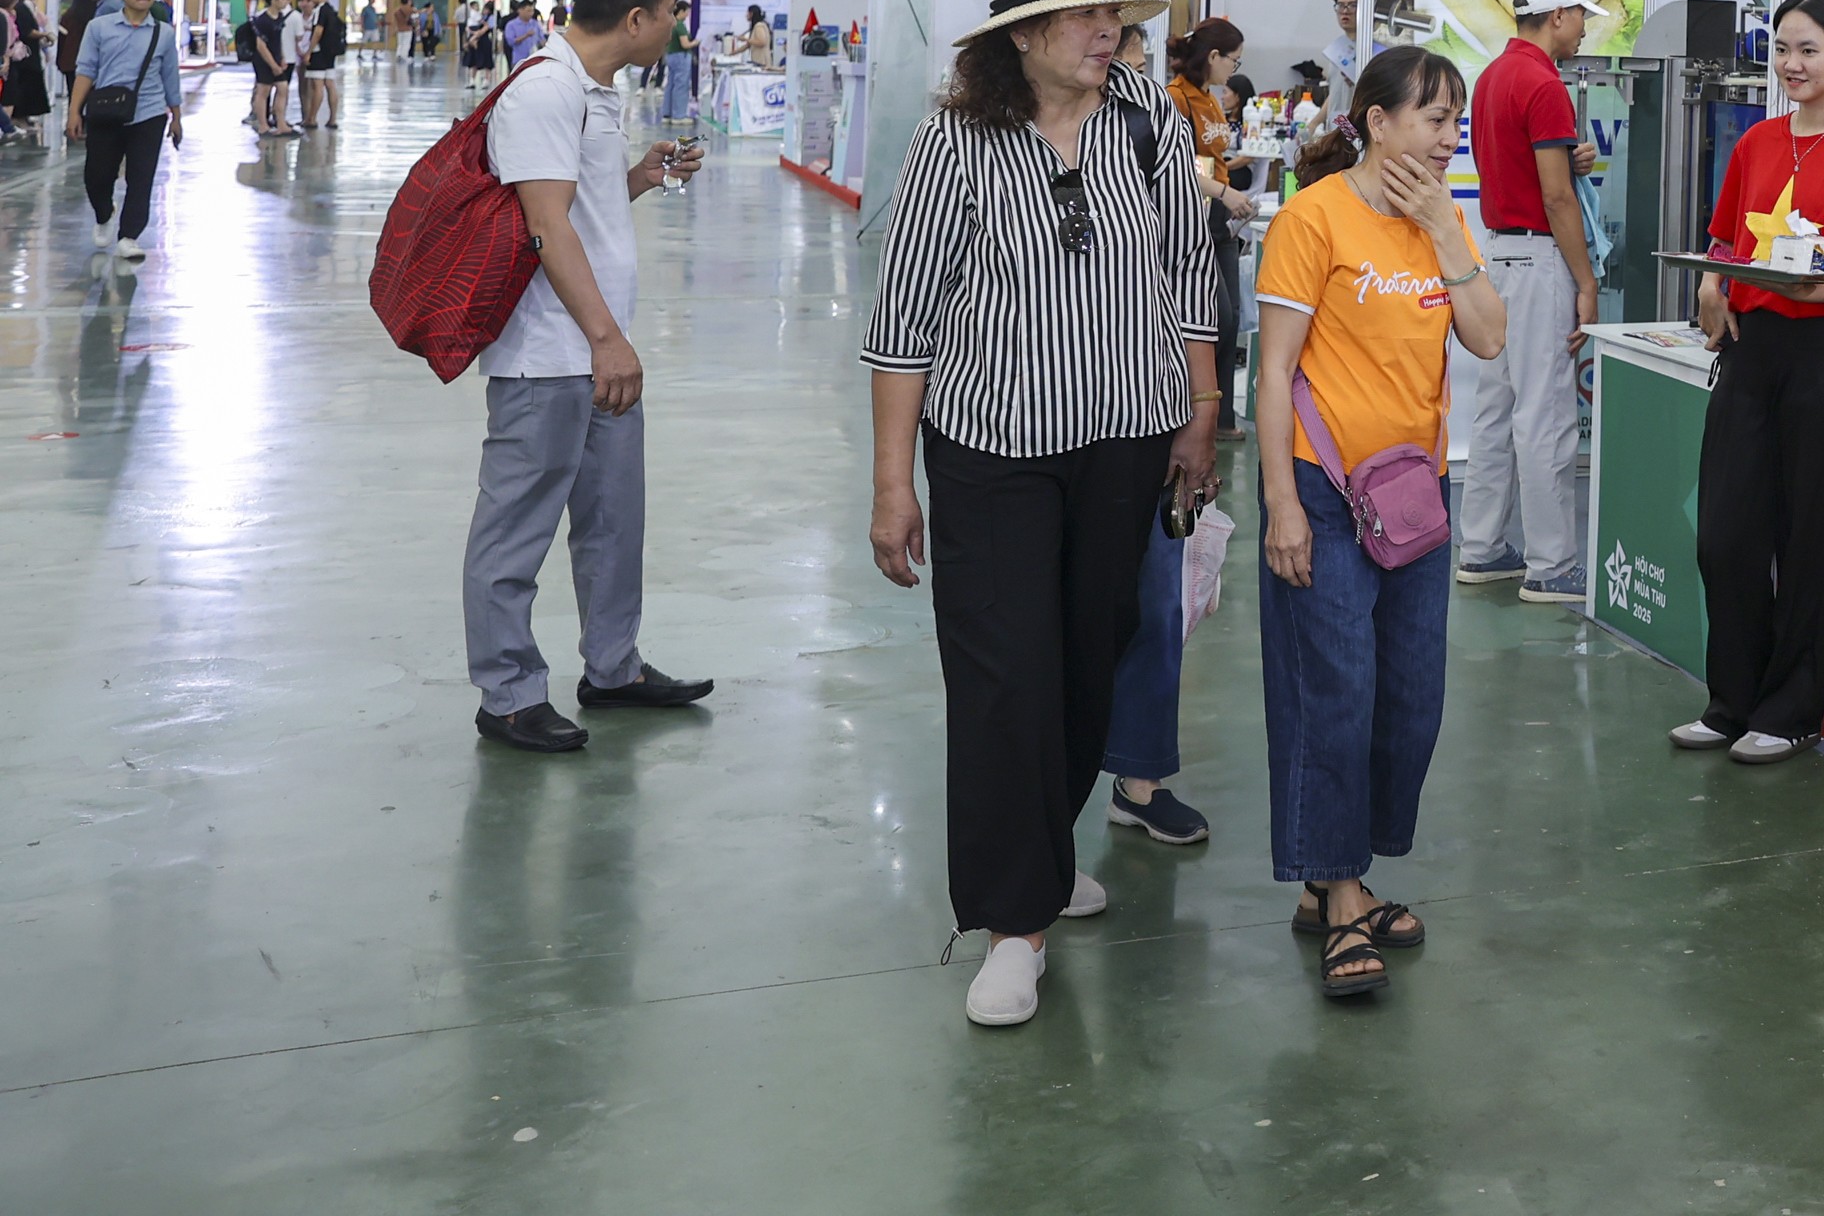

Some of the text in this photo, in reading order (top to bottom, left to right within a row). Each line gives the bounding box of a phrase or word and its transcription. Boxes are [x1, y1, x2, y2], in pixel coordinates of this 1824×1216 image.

[1354, 260, 1444, 304] Fratern
[1635, 555, 1665, 587] HỘI CHỢ
[1634, 579, 1666, 608] MÙA THU
[1633, 603, 1651, 624] 2025
